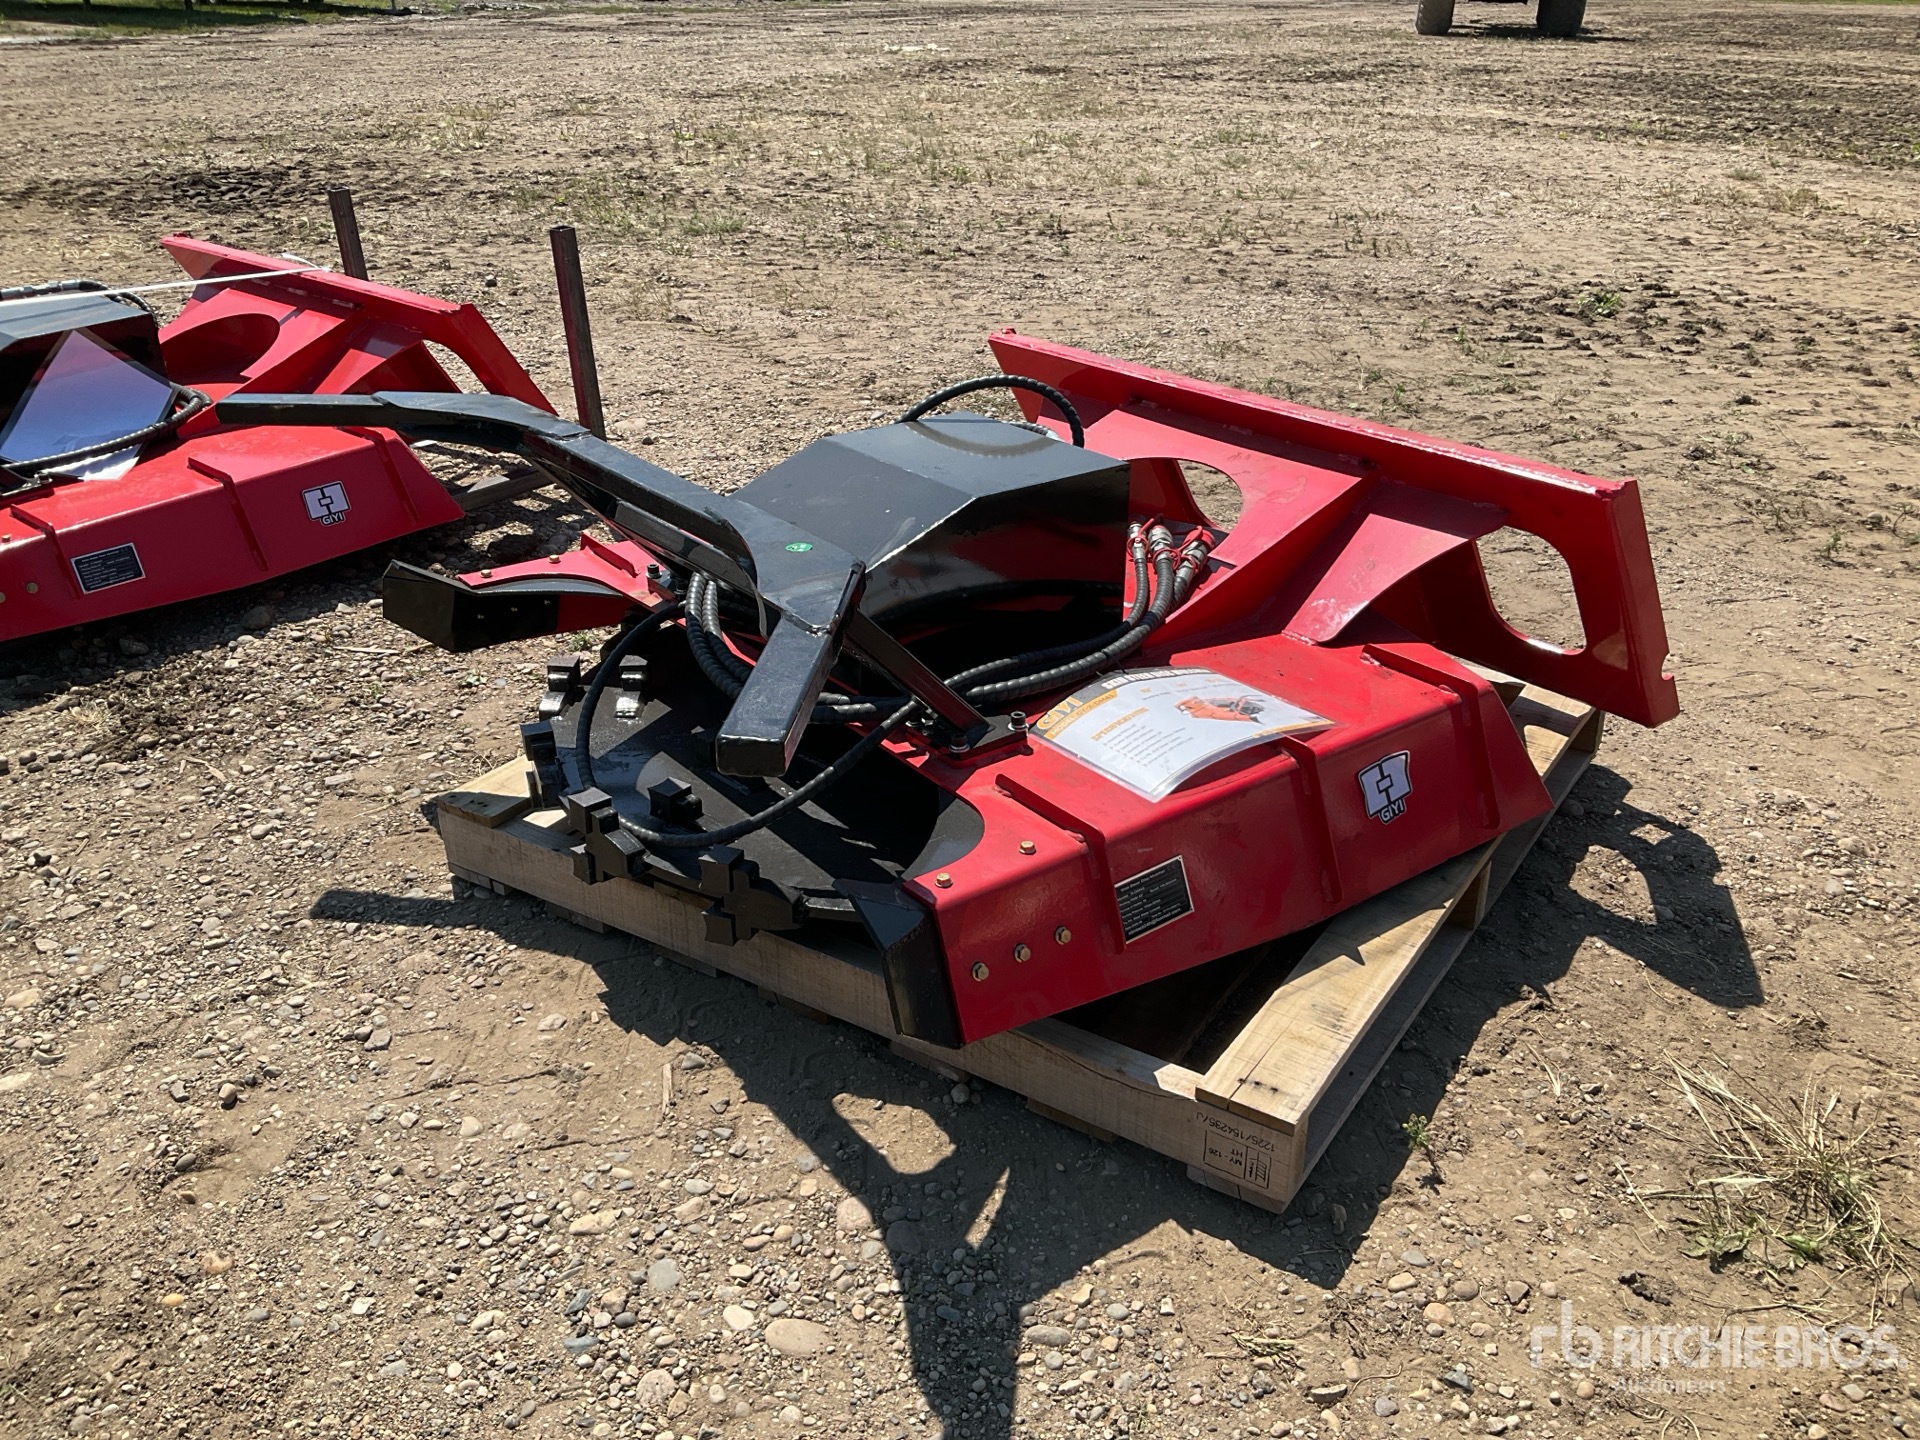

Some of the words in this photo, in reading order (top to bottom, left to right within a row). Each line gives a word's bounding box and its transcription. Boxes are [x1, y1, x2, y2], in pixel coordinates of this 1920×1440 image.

[322, 512, 343, 525] GIYI
[1036, 696, 1083, 730] GIYI
[1380, 800, 1404, 822] GIYI
[1230, 1148, 1243, 1158] HT
